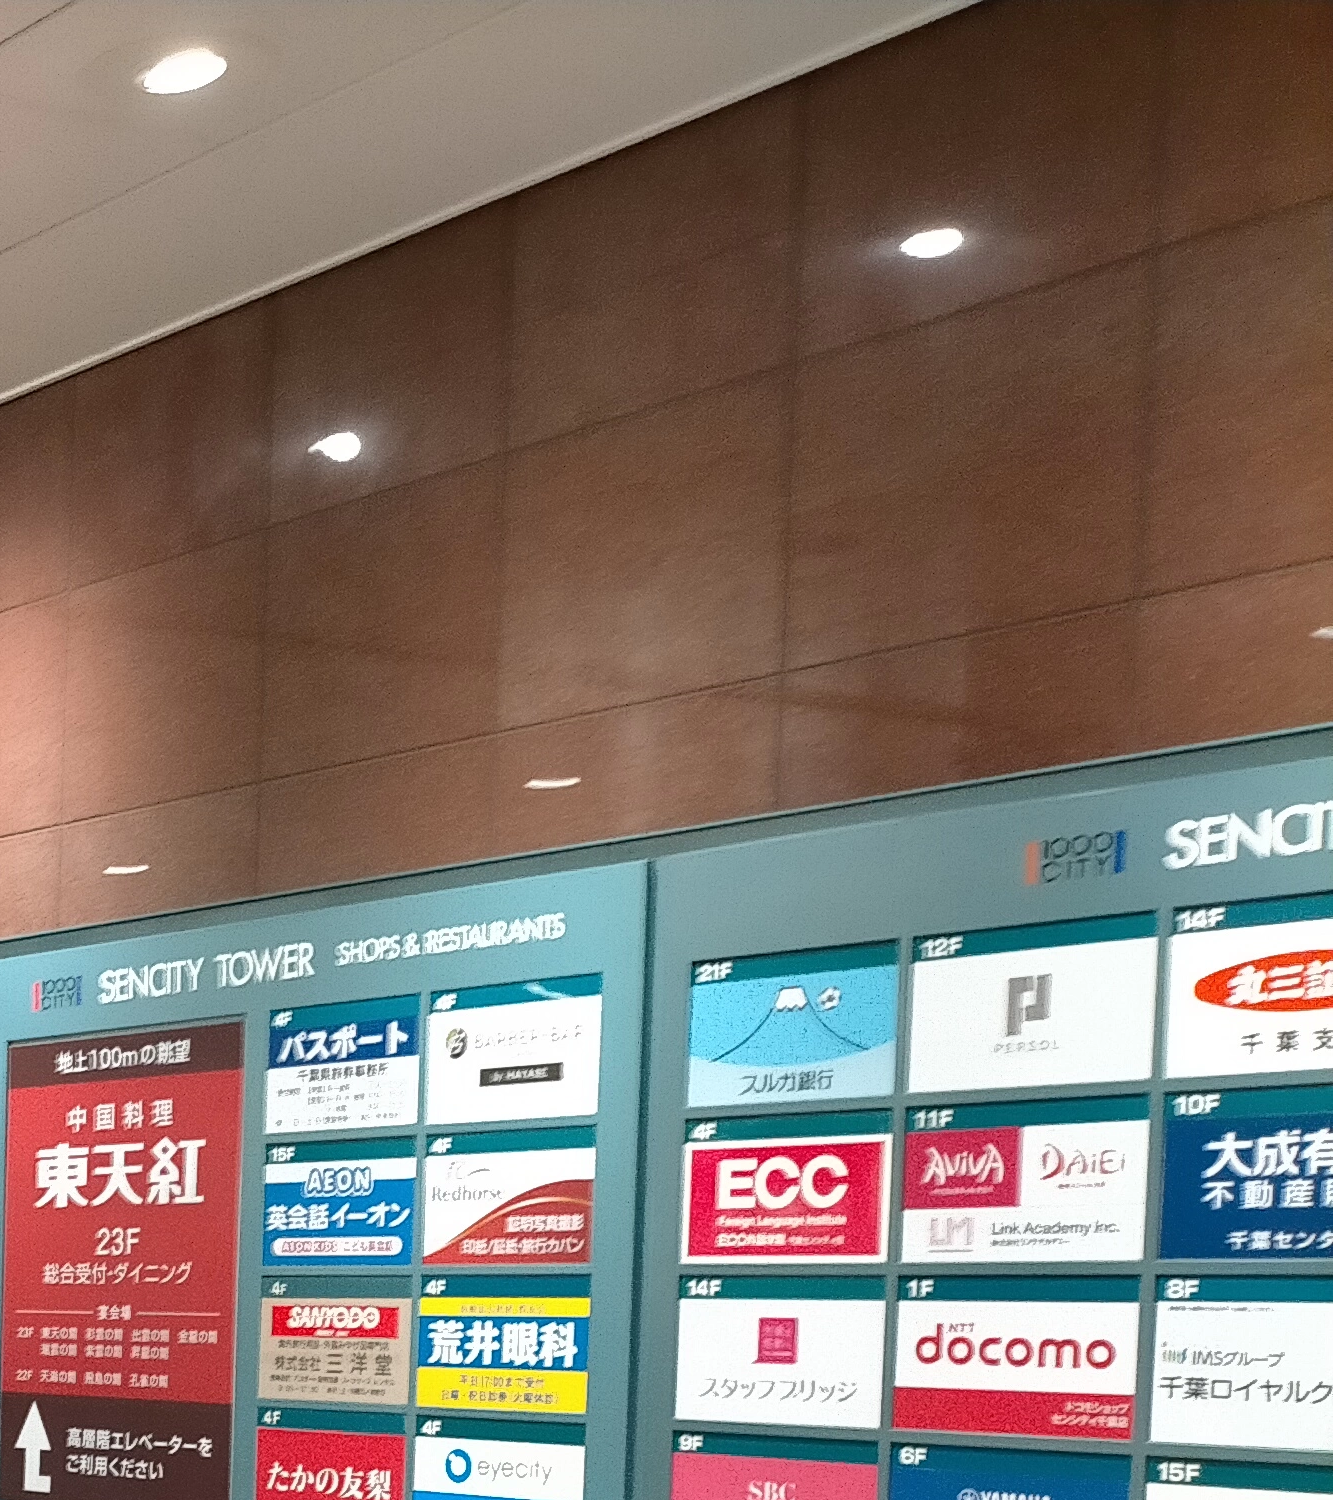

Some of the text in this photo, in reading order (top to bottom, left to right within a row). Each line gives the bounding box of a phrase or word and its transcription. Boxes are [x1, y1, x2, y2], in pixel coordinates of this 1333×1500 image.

[1043, 831, 1113, 860] 1000
[1042, 855, 1112, 883] CITY
[1175, 906, 1226, 932] 14F
[98, 912, 566, 1005] SENCITY TOWER SHOPS & RESTAURANTS
[920, 935, 963, 959] 12F
[276, 1021, 409, 1064] パスポート
[54, 1039, 191, 1074] 地上100mの眺望
[737, 1069, 834, 1096] スルガ銀行
[66, 1098, 174, 1133] 中国料理
[1172, 1093, 1221, 1116] 10F
[913, 1109, 954, 1129] 11F
[268, 1146, 296, 1162] 15F
[1200, 1128, 1333, 1179] 大成有
[35, 1136, 207, 1208] 東天紅
[306, 1166, 372, 1194] AEON
[715, 1154, 849, 1210] ECC
[432, 1185, 503, 1202] Redhorse
[265, 1201, 411, 1231] 英会話イーオン
[991, 1221, 1020, 1236] Link
[1023, 1220, 1090, 1237] Academy
[94, 1227, 141, 1256] 23F
[271, 1281, 288, 1295] 4F
[685, 1279, 722, 1297] 14F
[906, 1278, 934, 1298] 1F
[1165, 1278, 1200, 1299] 8F
[96, 1305, 132, 1321] 宴会場
[947, 1322, 975, 1333] NTT
[427, 1319, 578, 1368] 荒井眼科
[916, 1322, 1117, 1369] docomo
[263, 1410, 281, 1425] 4F
[420, 1419, 442, 1435] 4F
[65, 1427, 213, 1458] 高層階エレベーターを
[678, 1435, 703, 1451] 9F
[65, 1454, 164, 1480] ご利用ください
[899, 1446, 928, 1466] 6F
[265, 1461, 392, 1500] たかの友梨
[477, 1460, 552, 1485] eyecity
[1158, 1461, 1201, 1482] 15F
